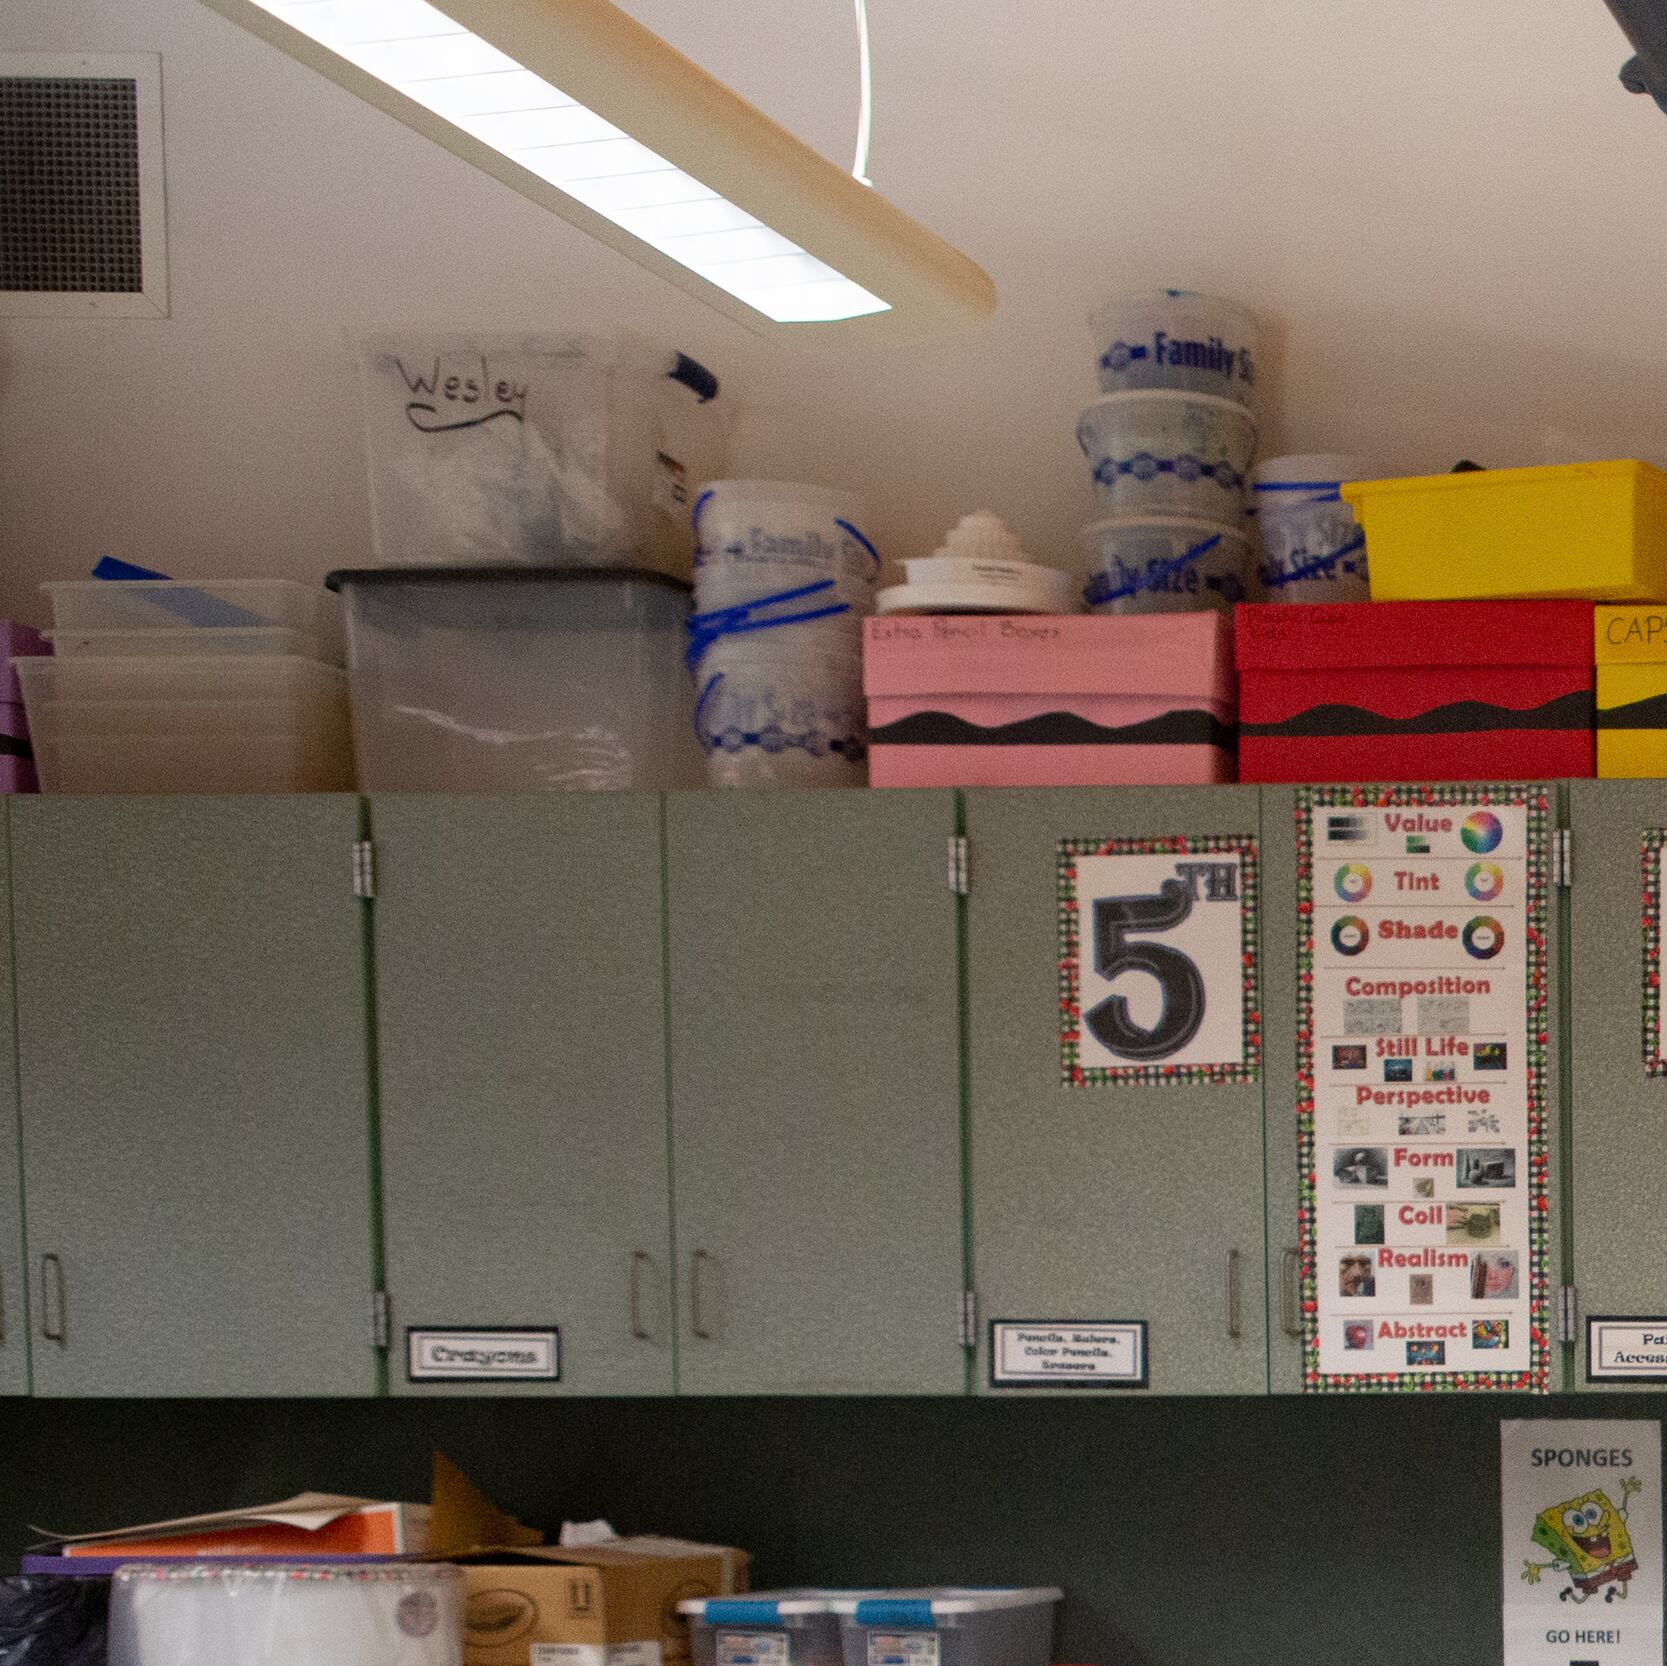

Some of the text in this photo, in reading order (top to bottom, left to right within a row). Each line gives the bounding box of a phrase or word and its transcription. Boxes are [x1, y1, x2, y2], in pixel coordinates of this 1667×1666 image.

[1154, 331, 1233, 379] Family
[392, 354, 529, 415] Wesley
[1384, 813, 1453, 833] Value
[1394, 872, 1440, 891] Tint
[1377, 920, 1458, 940] Shade
[1345, 977, 1491, 997] Composition
[1375, 1037, 1469, 1057] Still Life
[1356, 1085, 1491, 1107] Perspective
[1393, 1148, 1455, 1168] Form
[1399, 1204, 1443, 1226] Coil
[1378, 1248, 1469, 1269] Realism
[1376, 1320, 1467, 1340] Abstract
[431, 1345, 537, 1365] Crayons
[1530, 1448, 1633, 1468] SPONGES
[1545, 1628, 1620, 1644] GO HERE!
